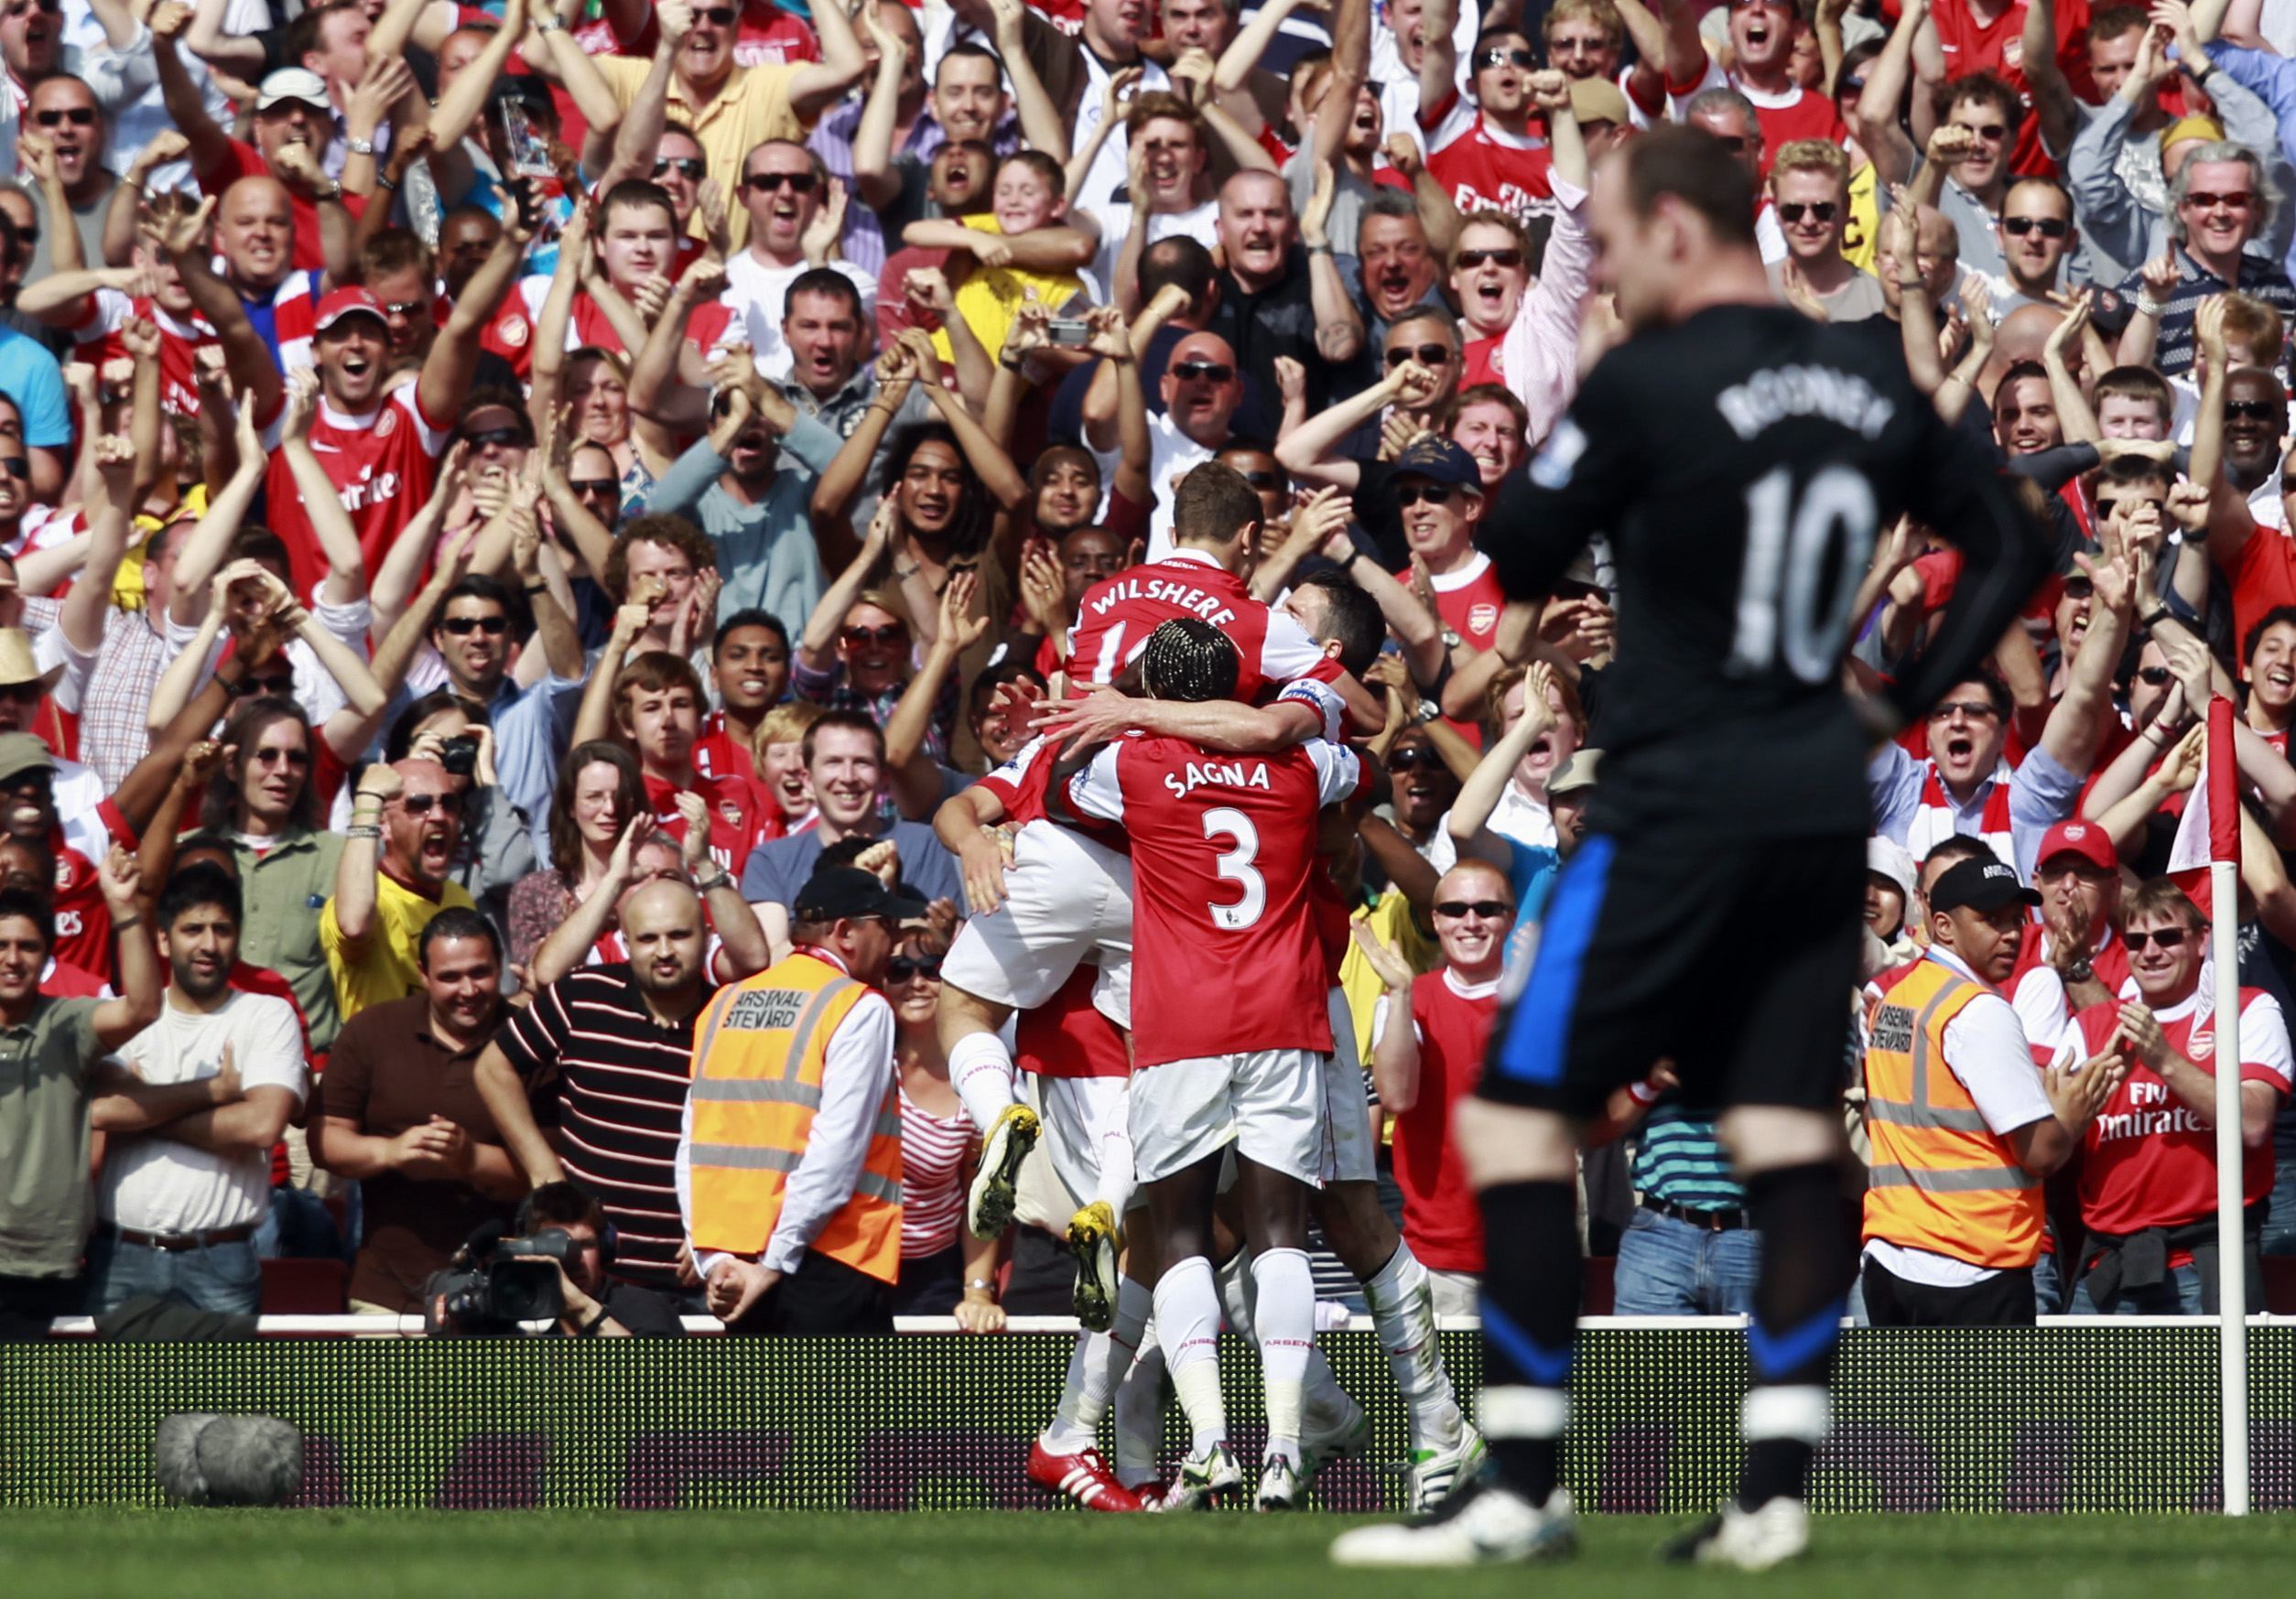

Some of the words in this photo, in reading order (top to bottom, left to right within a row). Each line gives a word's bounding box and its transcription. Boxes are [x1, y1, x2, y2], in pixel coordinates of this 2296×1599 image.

[1717, 364, 1894, 440] ROONEY
[1090, 578, 1236, 628] WILSHERE
[1735, 465, 1877, 682] 10
[1164, 762, 1271, 799] SAGNA
[1201, 806, 1267, 931] 3
[2129, 1082, 2169, 1106] Fly
